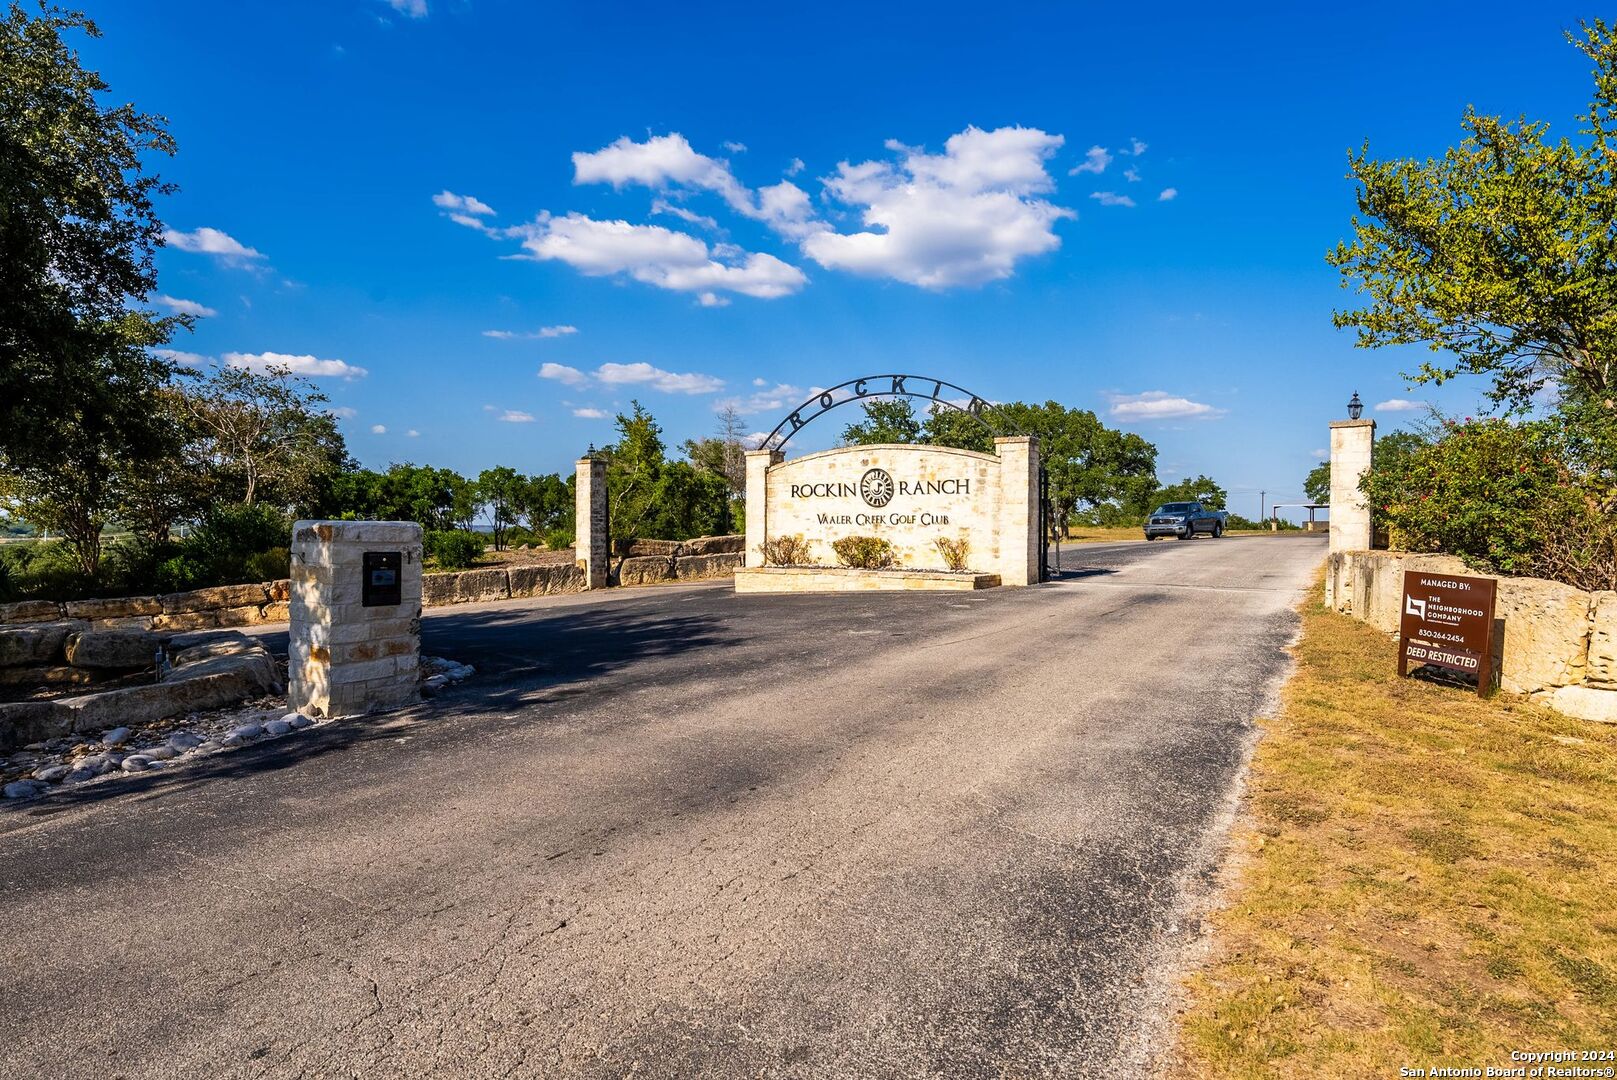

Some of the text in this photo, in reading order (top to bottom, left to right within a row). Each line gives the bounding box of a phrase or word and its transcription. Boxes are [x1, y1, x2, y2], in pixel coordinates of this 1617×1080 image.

[791, 479, 970, 498] ROCKIN RANCH
[816, 513, 949, 526] VAALER CREEK GOLF CLUB
[1420, 579, 1471, 591] MANAGED BY:
[1427, 612, 1462, 622] COMPANY
[1428, 604, 1484, 617] NEIGHBORHOOD
[1418, 629, 1465, 643] 830-264-2454
[1406, 646, 1477, 668] DEED RESTRICTED
